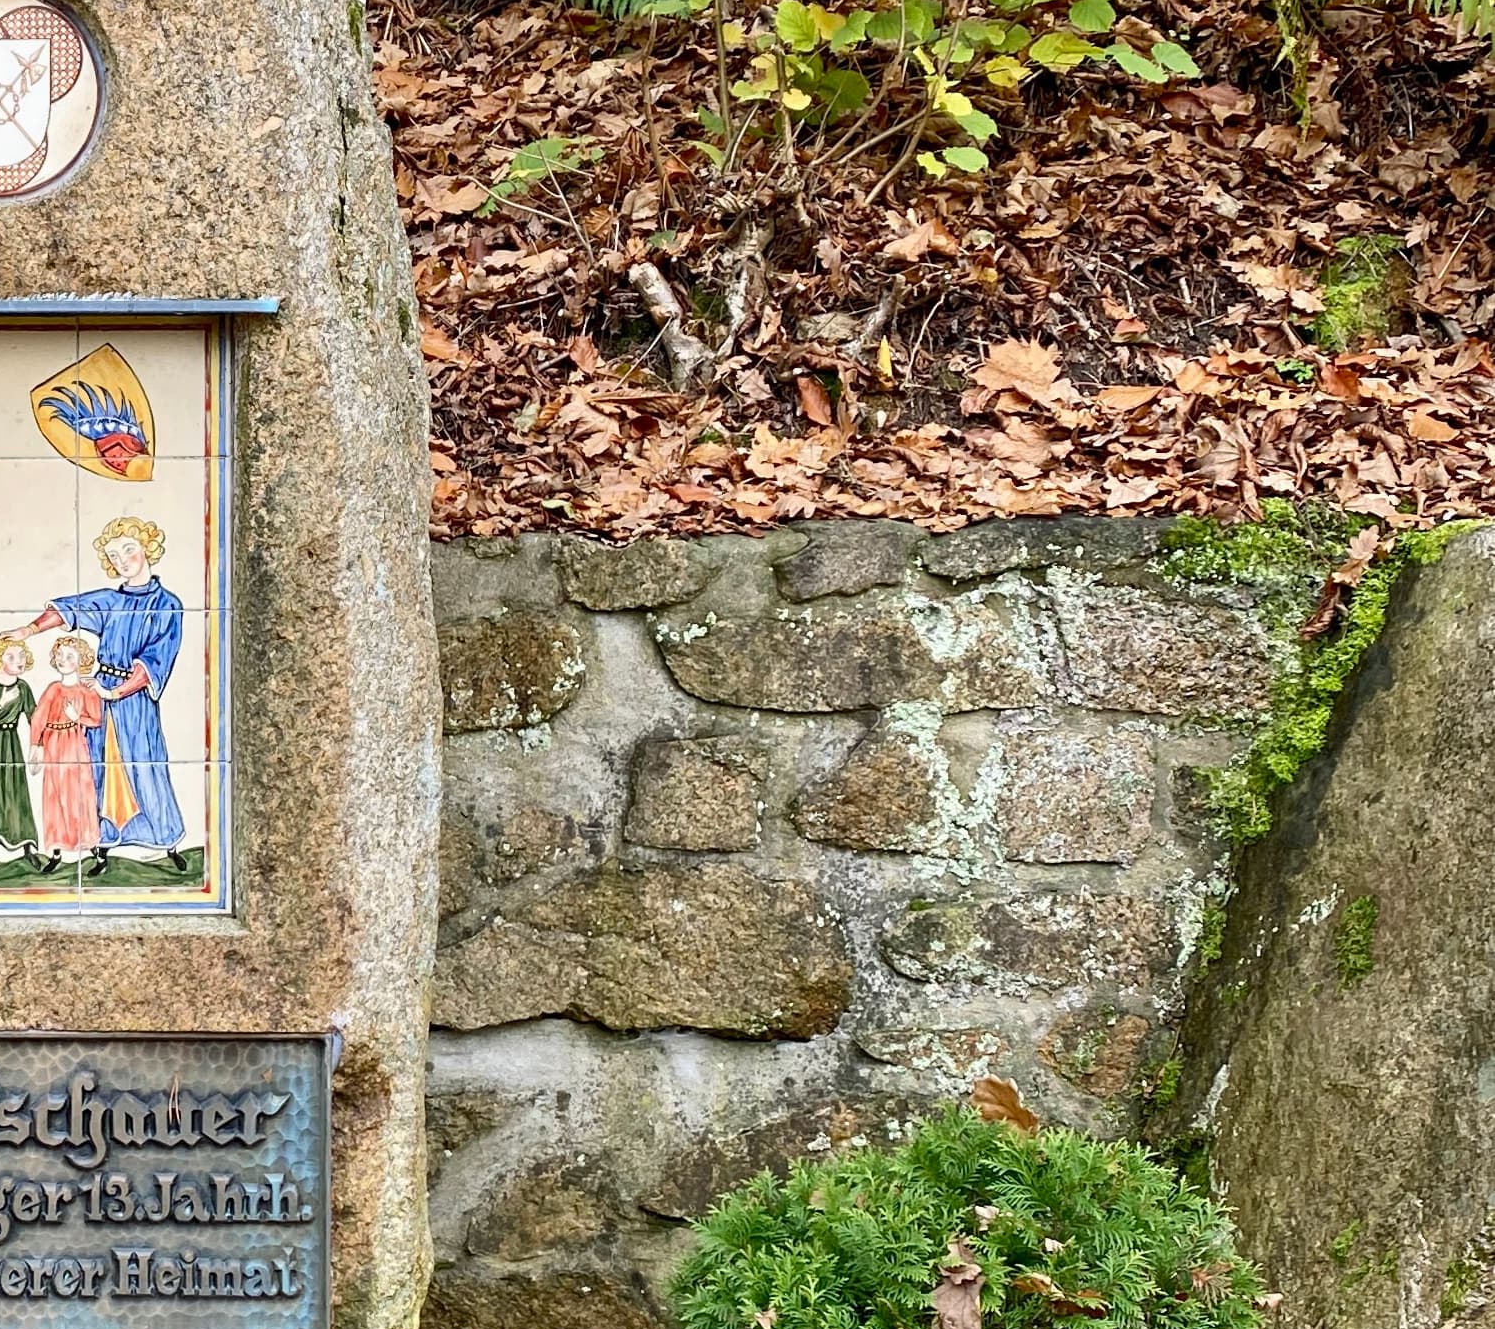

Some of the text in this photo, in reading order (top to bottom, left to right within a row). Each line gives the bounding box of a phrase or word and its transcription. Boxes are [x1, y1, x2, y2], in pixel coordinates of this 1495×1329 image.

[79, 1173, 147, 1222] 13.
[147, 1173, 313, 1223] Jahrh.
[111, 1245, 303, 1298] Heimat
